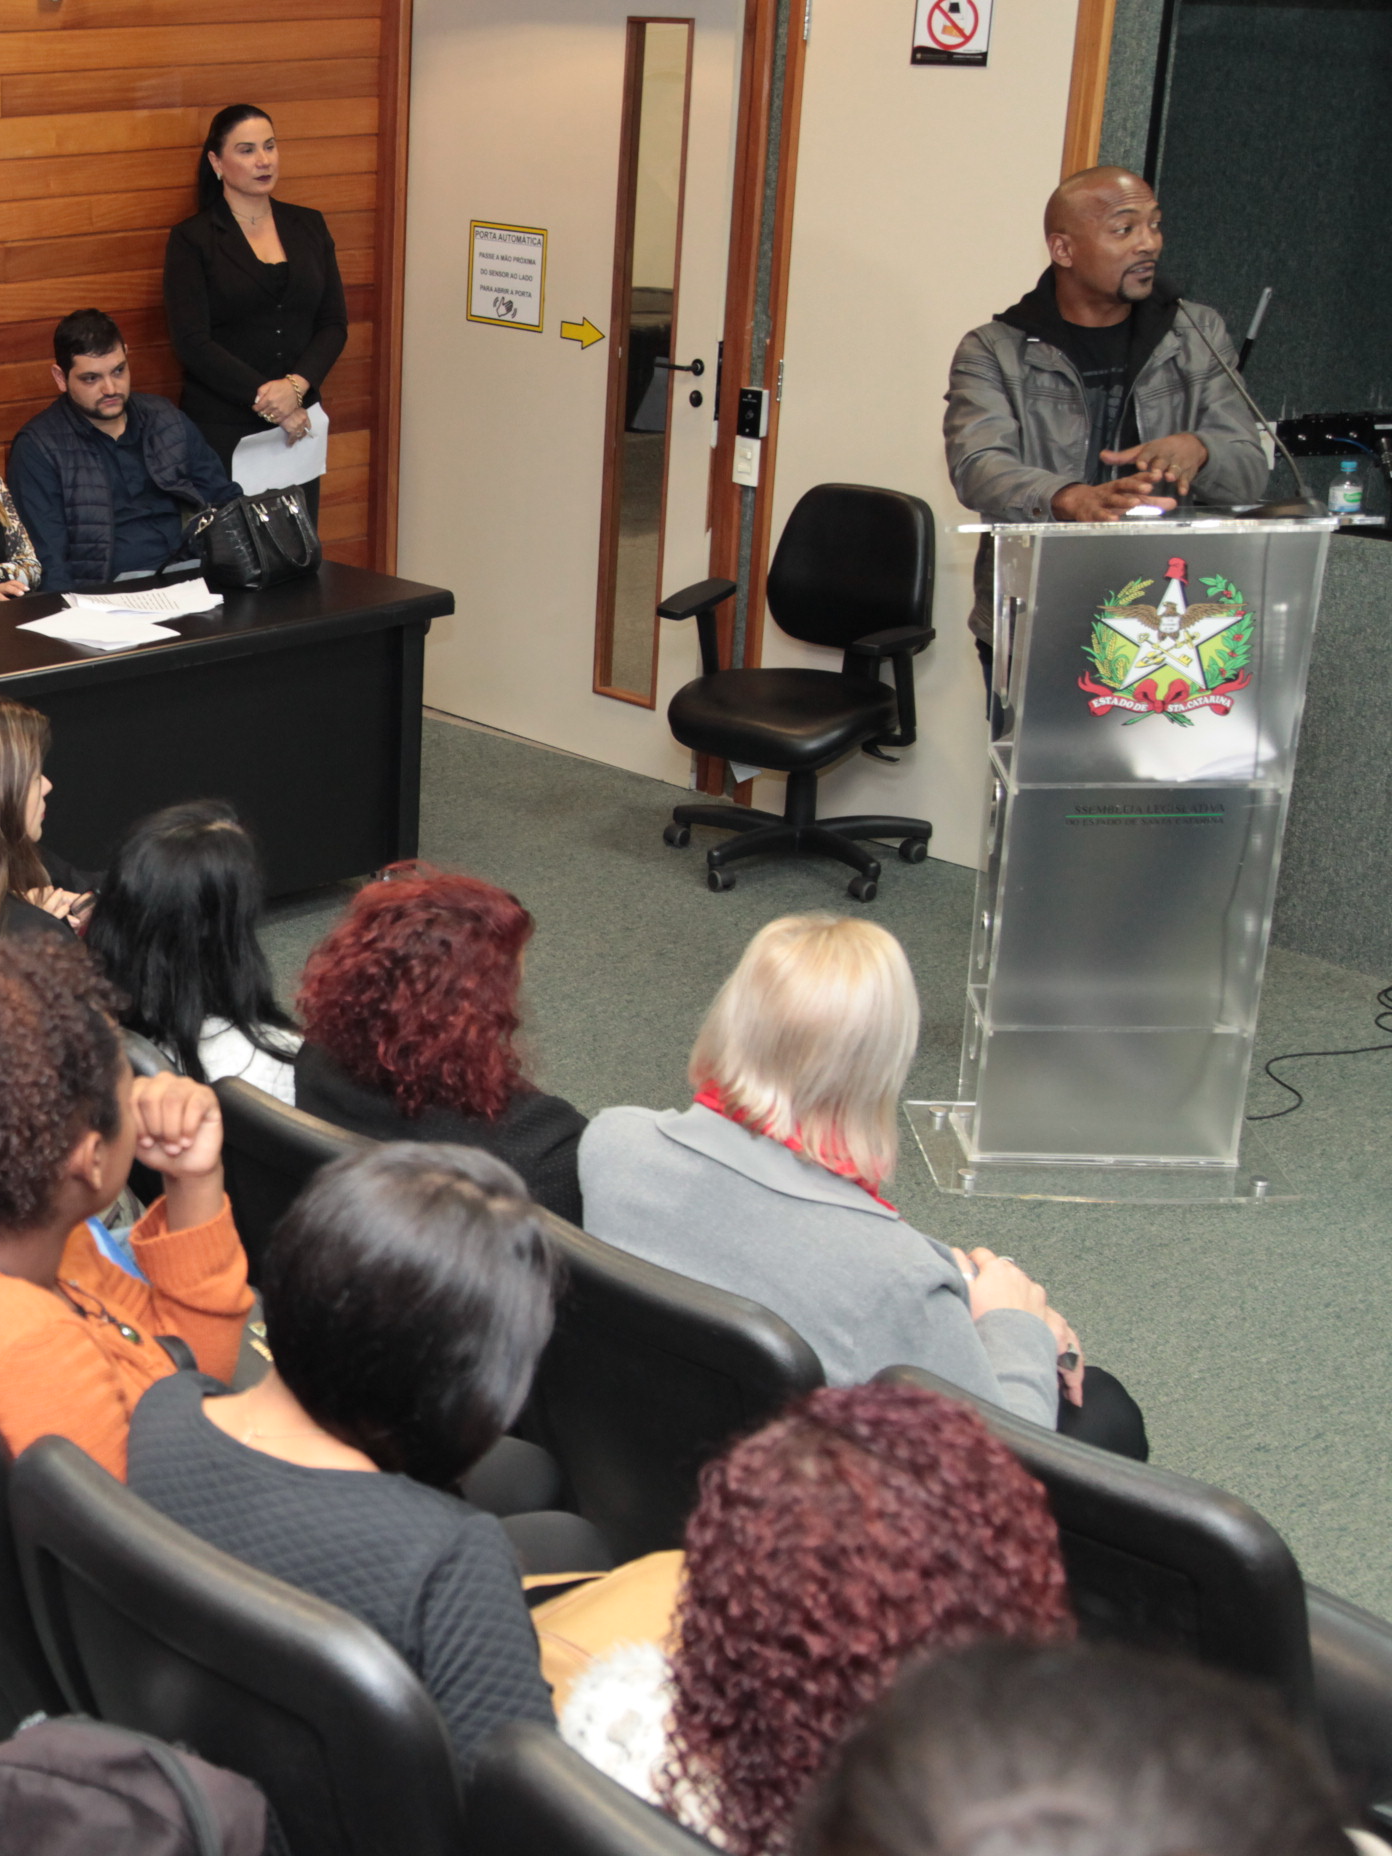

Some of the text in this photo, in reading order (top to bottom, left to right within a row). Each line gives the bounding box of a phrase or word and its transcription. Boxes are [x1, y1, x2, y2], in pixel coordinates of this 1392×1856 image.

[475, 230, 496, 240] PORTA
[489, 269, 509, 278] SENSOR
[519, 274, 533, 282] LADO
[515, 290, 532, 298] PORTA
[1091, 696, 1134, 708] ESTADO
[1133, 702, 1148, 712] DE
